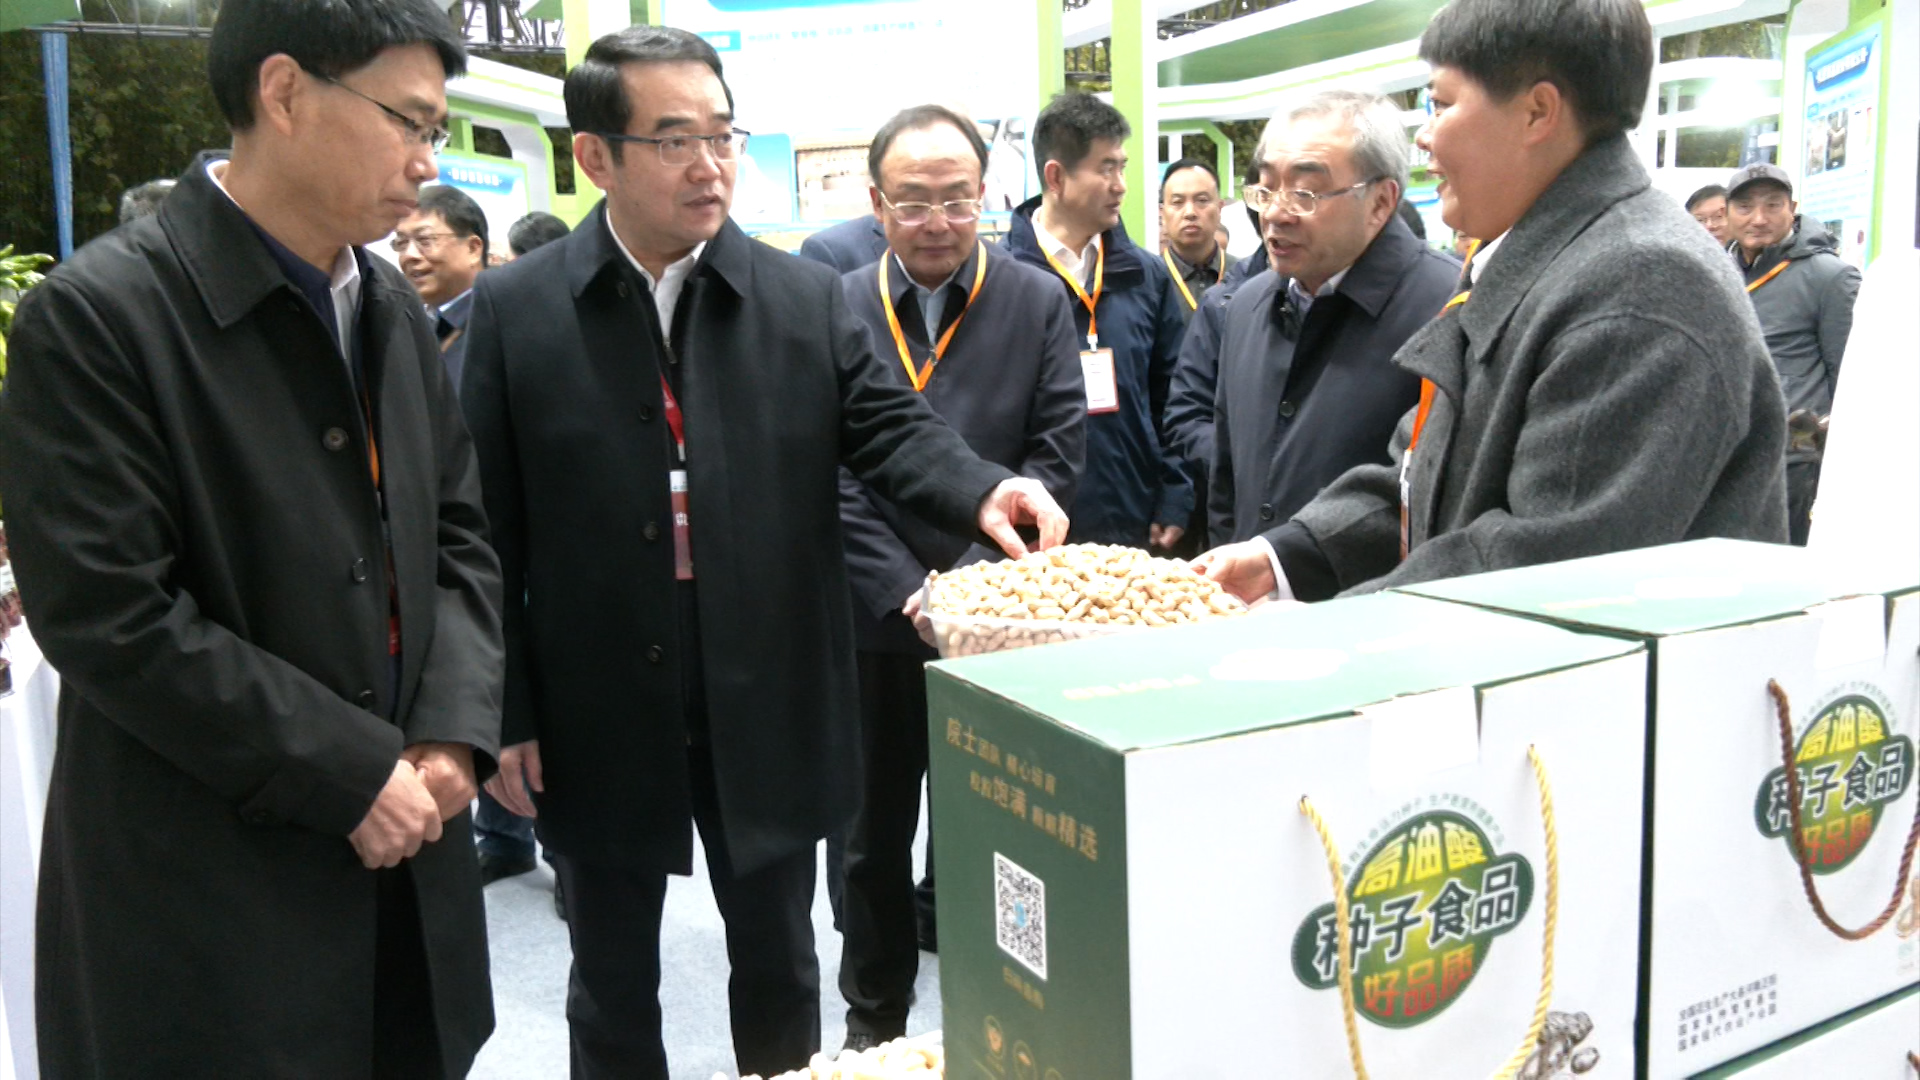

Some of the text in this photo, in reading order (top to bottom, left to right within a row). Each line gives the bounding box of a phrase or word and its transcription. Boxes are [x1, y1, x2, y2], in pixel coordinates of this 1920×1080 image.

[1794, 703, 1886, 764] 高油酸
[1766, 741, 1906, 832] 种子食品
[1353, 821, 1488, 897] 高油酸
[1802, 808, 1873, 864] 好品质
[1312, 862, 1519, 982] 种子食品
[1363, 944, 1476, 1017] 好品质
